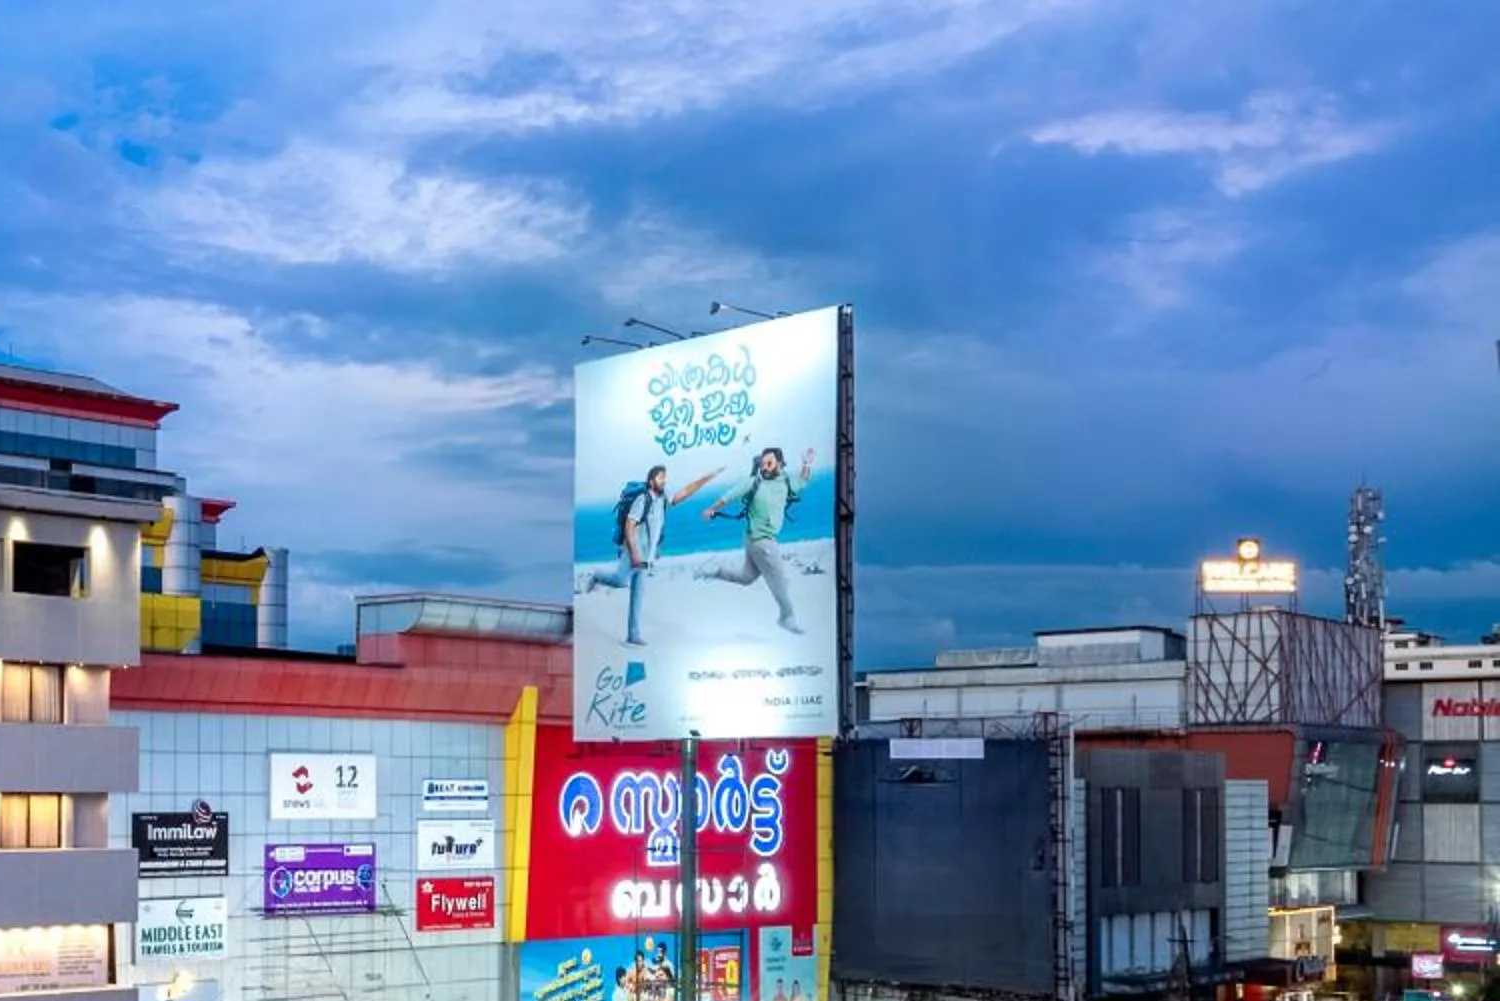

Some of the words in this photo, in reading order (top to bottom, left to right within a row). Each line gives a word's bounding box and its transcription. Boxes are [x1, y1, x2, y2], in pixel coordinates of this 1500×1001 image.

[596, 665, 623, 691] Go
[585, 692, 646, 727] Kite
[335, 764, 359, 788] 12
[147, 822, 218, 841] ImmiLaw
[293, 869, 355, 891] corpus
[431, 892, 487, 916] Flywell
[141, 925, 193, 942] MIDDLE
[195, 922, 223, 940] EAST
[141, 944, 177, 956] TRAVELS
